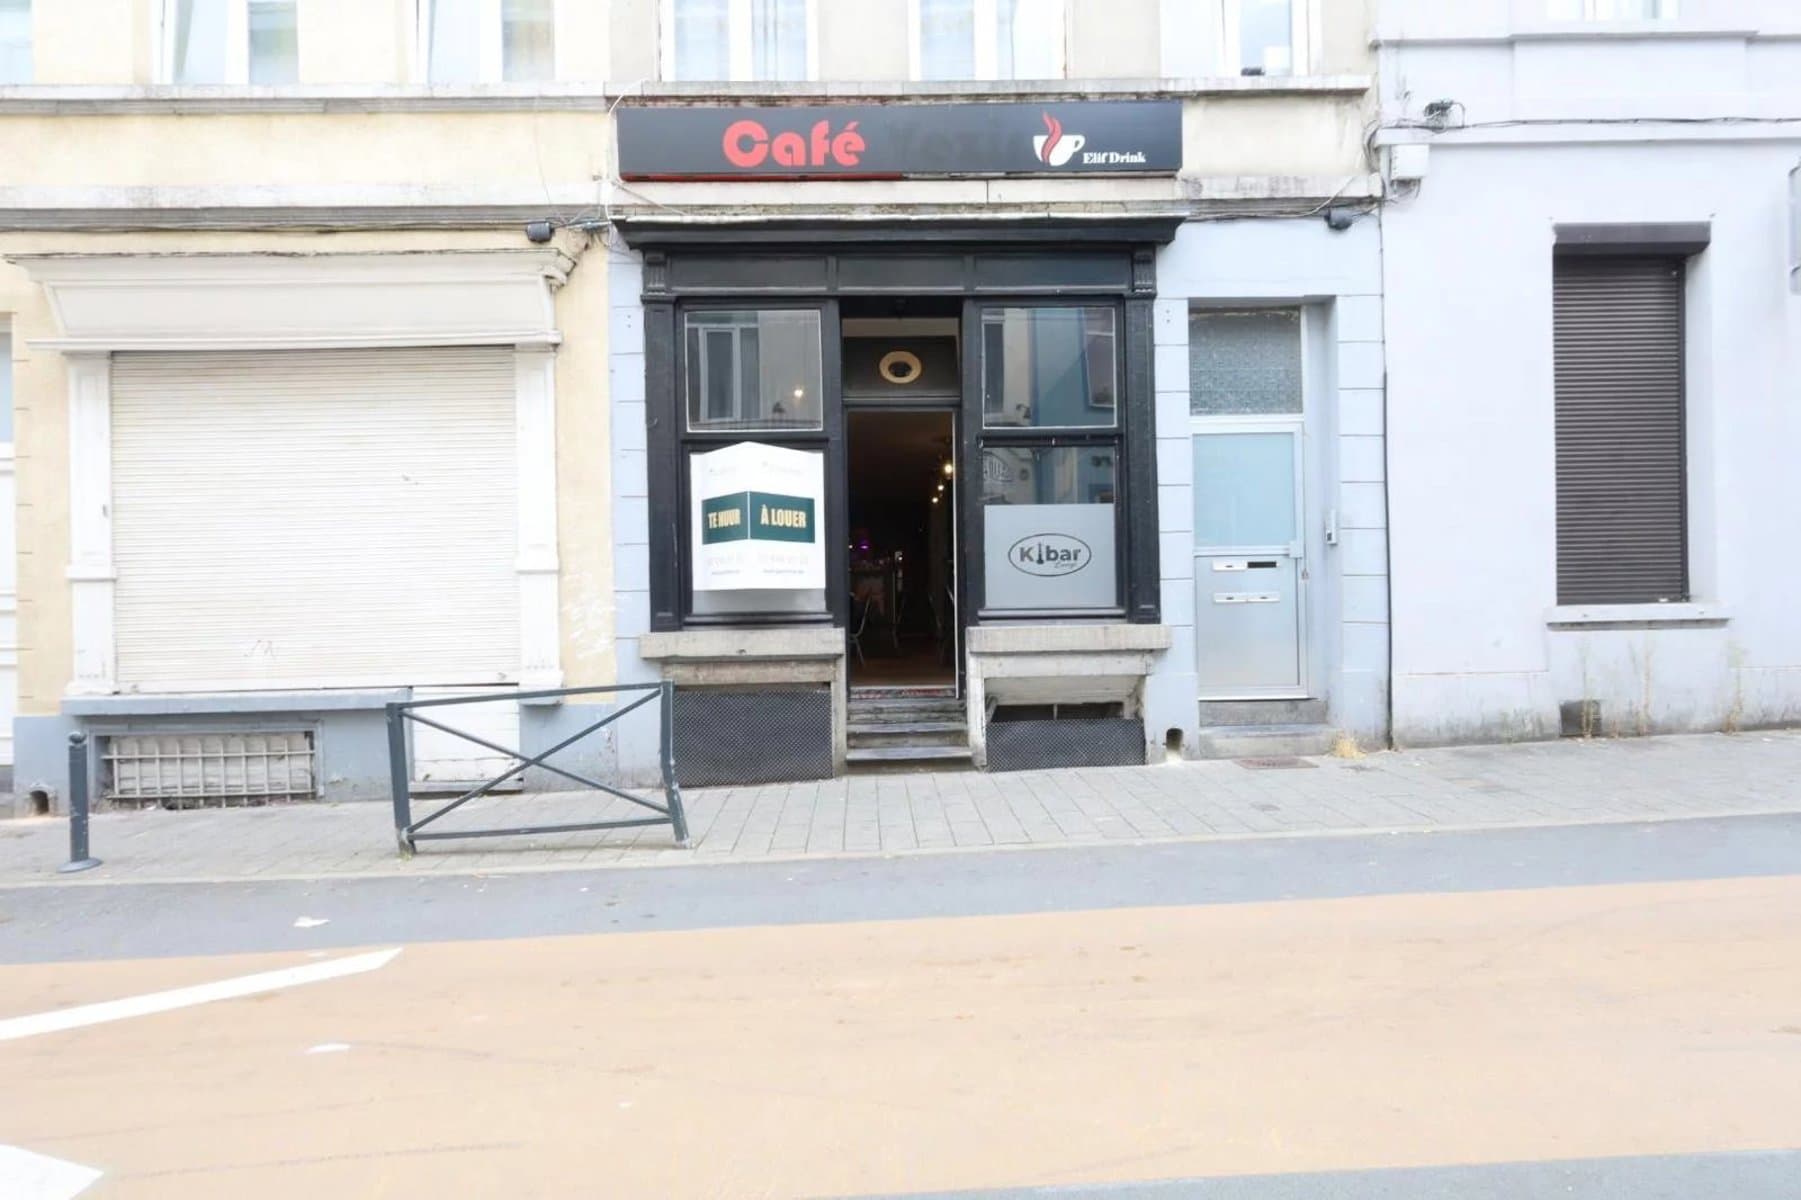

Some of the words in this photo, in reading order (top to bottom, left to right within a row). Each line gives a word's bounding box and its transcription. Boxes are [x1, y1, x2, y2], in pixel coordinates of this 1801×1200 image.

[722, 119, 866, 168] Café
[1083, 151, 1108, 164] Elif
[1109, 151, 1146, 164] Drink
[708, 511, 718, 529] TE
[760, 504, 770, 526] À
[771, 507, 807, 529] LOUER
